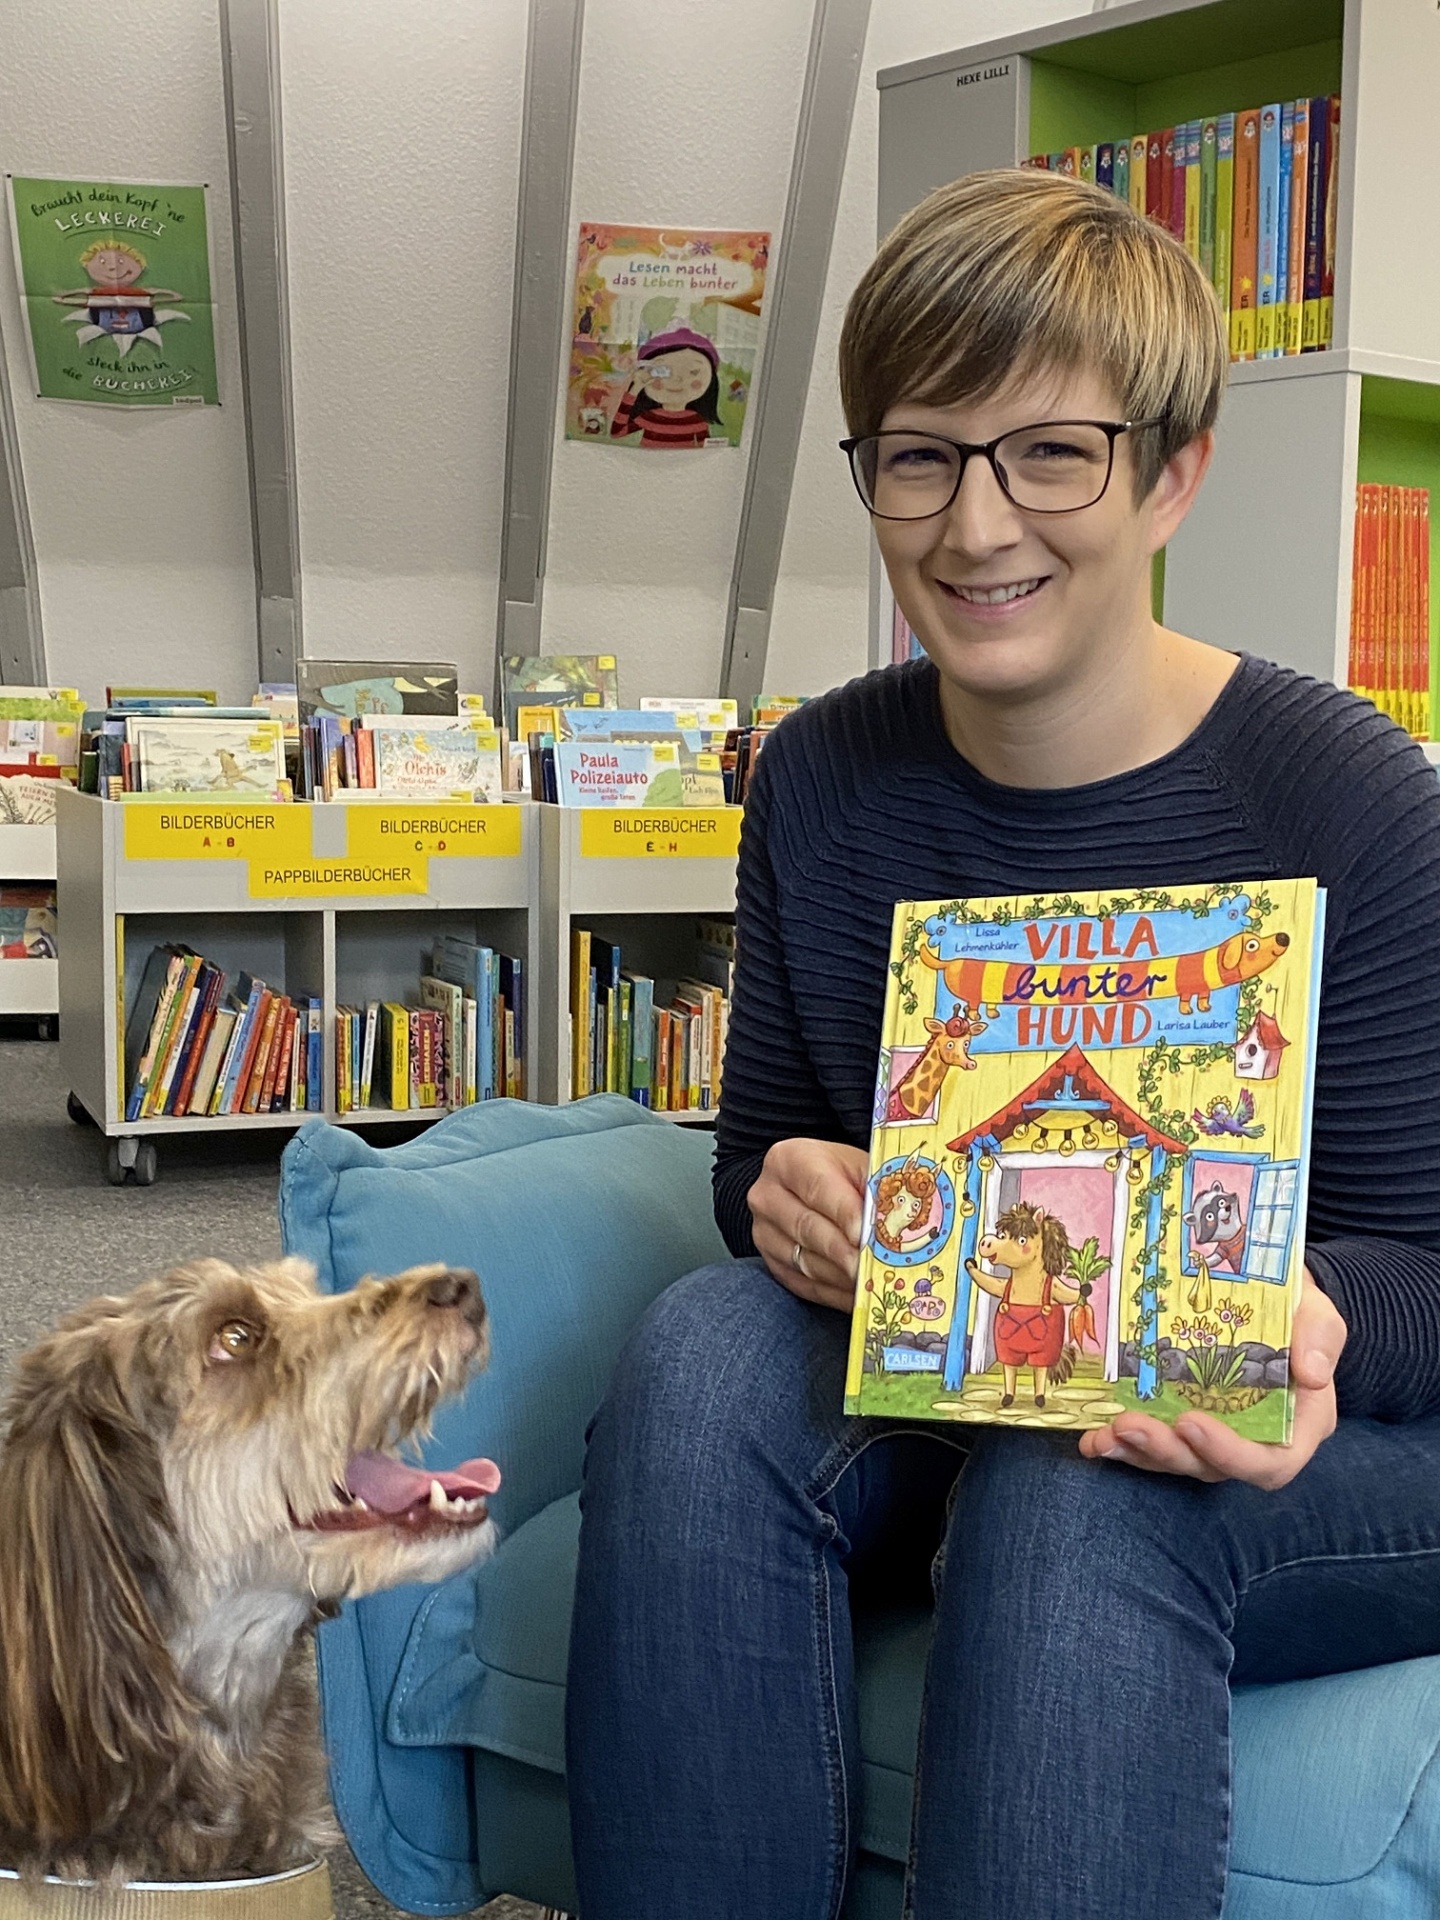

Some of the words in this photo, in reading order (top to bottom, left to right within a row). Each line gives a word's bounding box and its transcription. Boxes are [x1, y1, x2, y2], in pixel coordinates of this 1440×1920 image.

[957, 71, 981, 86] HEXE
[984, 65, 1009, 80] LILLI
[31, 190, 83, 217] Braucht
[88, 188, 120, 203] dein
[126, 192, 159, 212] Kopf
[54, 211, 167, 237] LECKEREI
[629, 261, 670, 273] Lesen
[676, 262, 718, 275] macht
[612, 273, 637, 286] das
[643, 275, 684, 288] Leben
[690, 276, 738, 290] bunter
[62, 366, 83, 380] die
[87, 357, 123, 373] steck
[127, 361, 152, 373] ihn
[153, 360, 170, 370] in
[580, 752, 619, 767] Paula
[570, 769, 648, 784] Polizeiauto
[160, 812, 275, 829] BILDERBÜCHER
[380, 817, 487, 833] BILDERBÜCHER
[613, 817, 717, 833] BILDERBÜCHER
[203, 836, 211, 847] A
[226, 837, 235, 847] B
[415, 840, 423, 851] C
[437, 840, 446, 851] D
[646, 841, 655, 852] E
[669, 842, 677, 852] H
[264, 866, 412, 884] PAPPBILDERBÜCHER
[976, 928, 1001, 937] Lissa
[1023, 916, 1160, 961] VILLA
[955, 941, 1020, 953] Lehmenkühler
[1003, 965, 1168, 1001] bunter
[1017, 1003, 1152, 1046] HUND
[1157, 1020, 1191, 1030] Larisa
[1193, 1019, 1231, 1029] Lauber
[886, 1353, 938, 1366] CARLSEN
